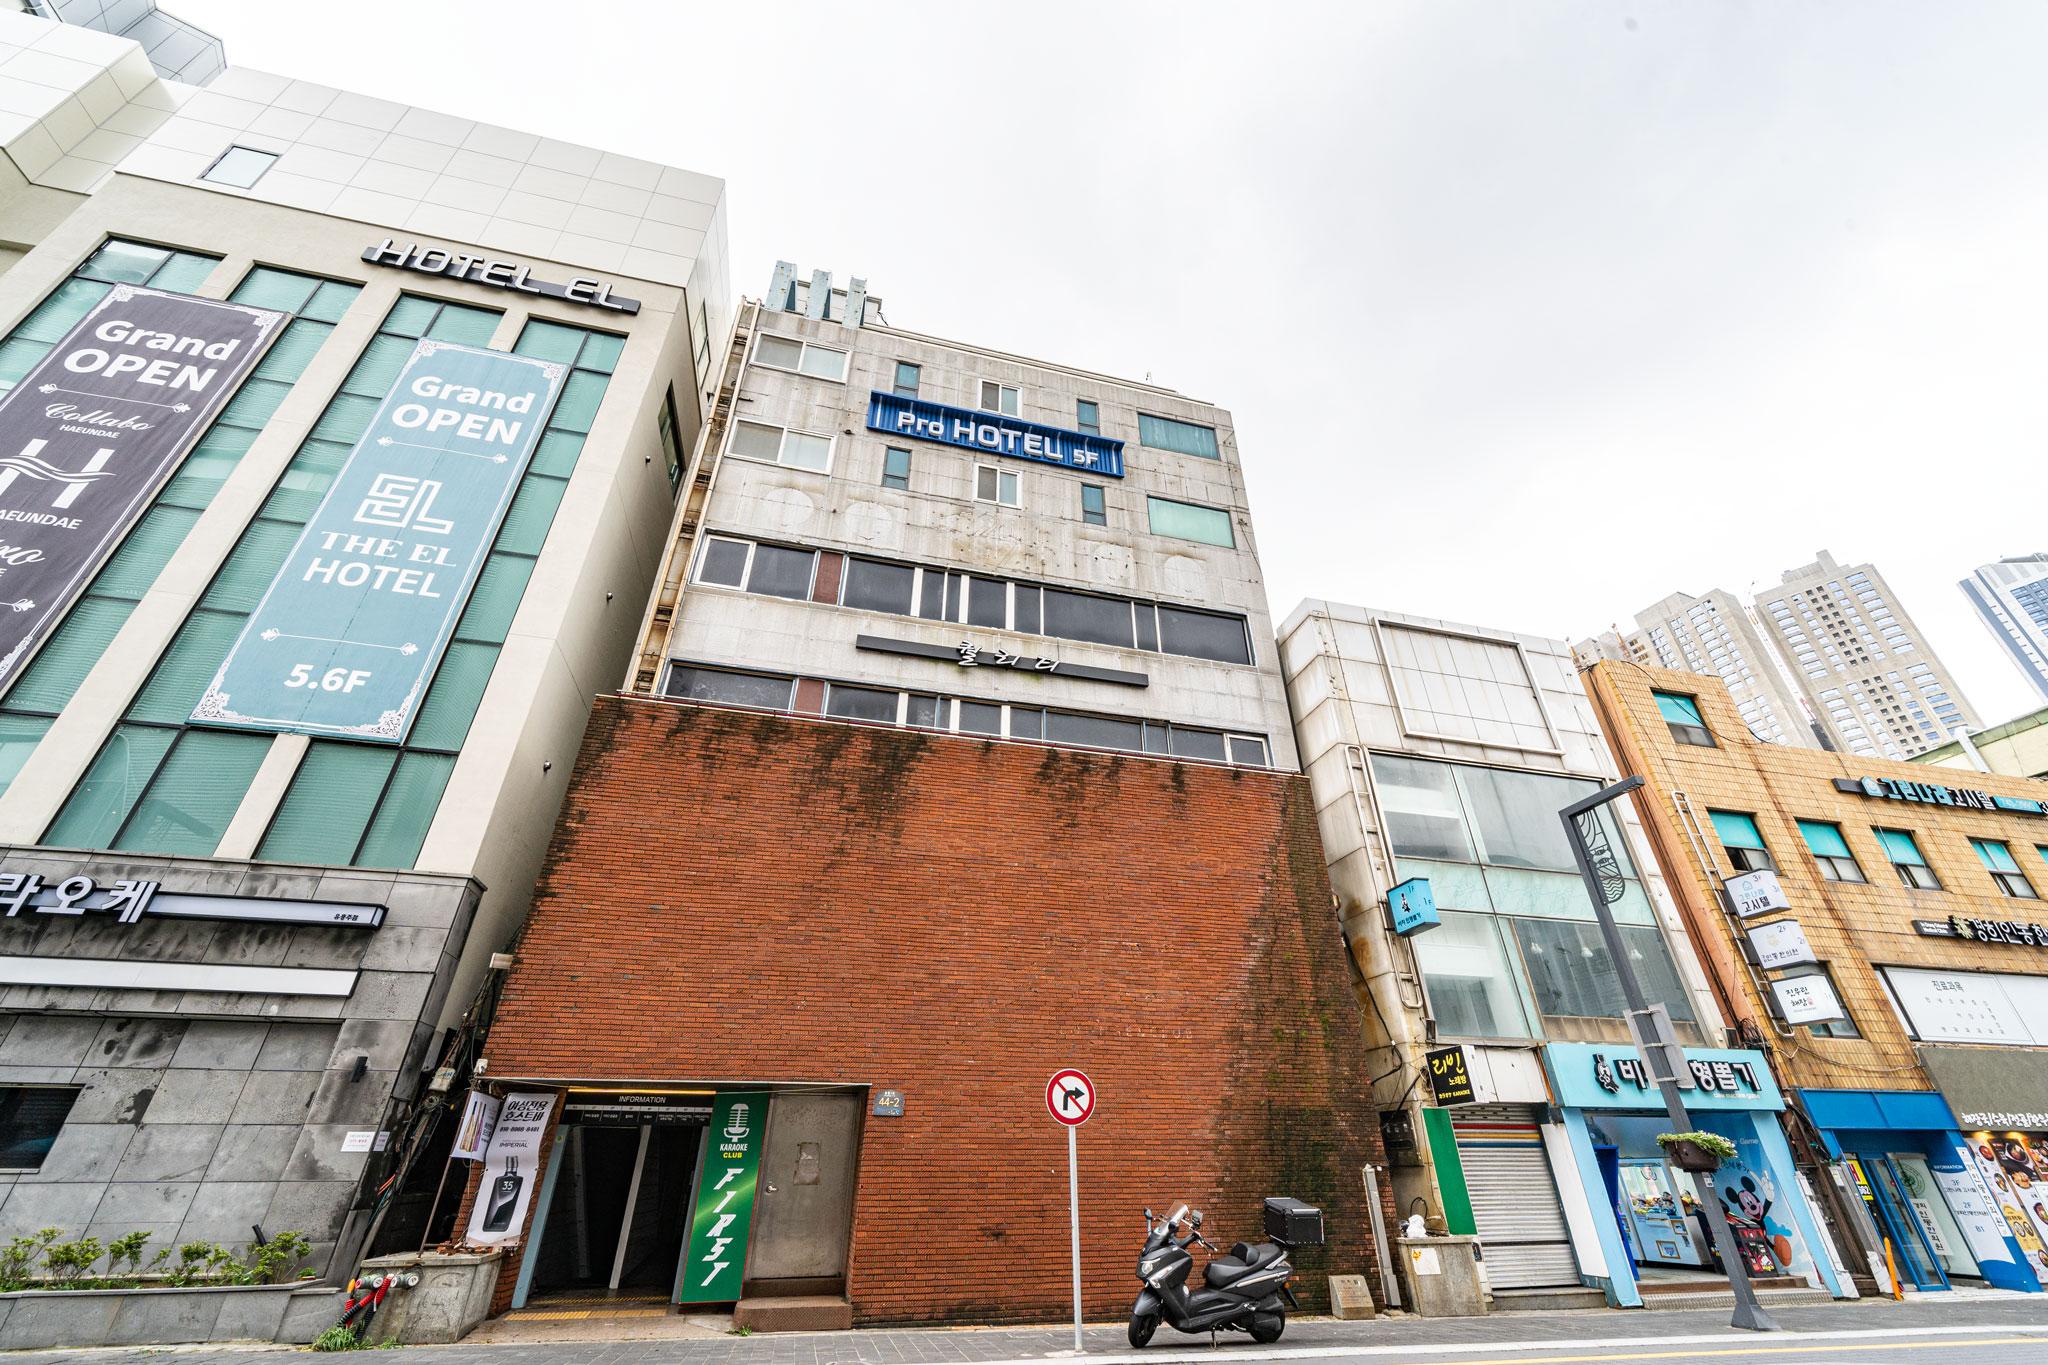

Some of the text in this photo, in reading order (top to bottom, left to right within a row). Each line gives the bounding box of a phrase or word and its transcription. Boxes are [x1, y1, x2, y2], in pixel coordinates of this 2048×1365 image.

[371, 238, 624, 311] HOTEL EL
[95, 320, 241, 361] Grand
[63, 348, 218, 392] OPEN
[411, 375, 536, 414] Grand
[45, 402, 156, 431] Collabo
[59, 424, 121, 439] HAEUNDAE
[392, 403, 523, 445] OPEN
[897, 411, 1099, 466] Pro HOTEL 5F
[320, 531, 457, 567] THE EL
[302, 557, 441, 598] HOTEL
[283, 663, 372, 694] 5.6F
[1742, 896, 1771, 912] 고시텔
[507, 1100, 549, 1112] 여성전용
[618, 1095, 667, 1104] INFORMATION
[878, 1097, 900, 1108] 44-2
[720, 1143, 748, 1151] KARAOKE
[502, 1181, 514, 1190] 35
[701, 1167, 745, 1287] FIRST
